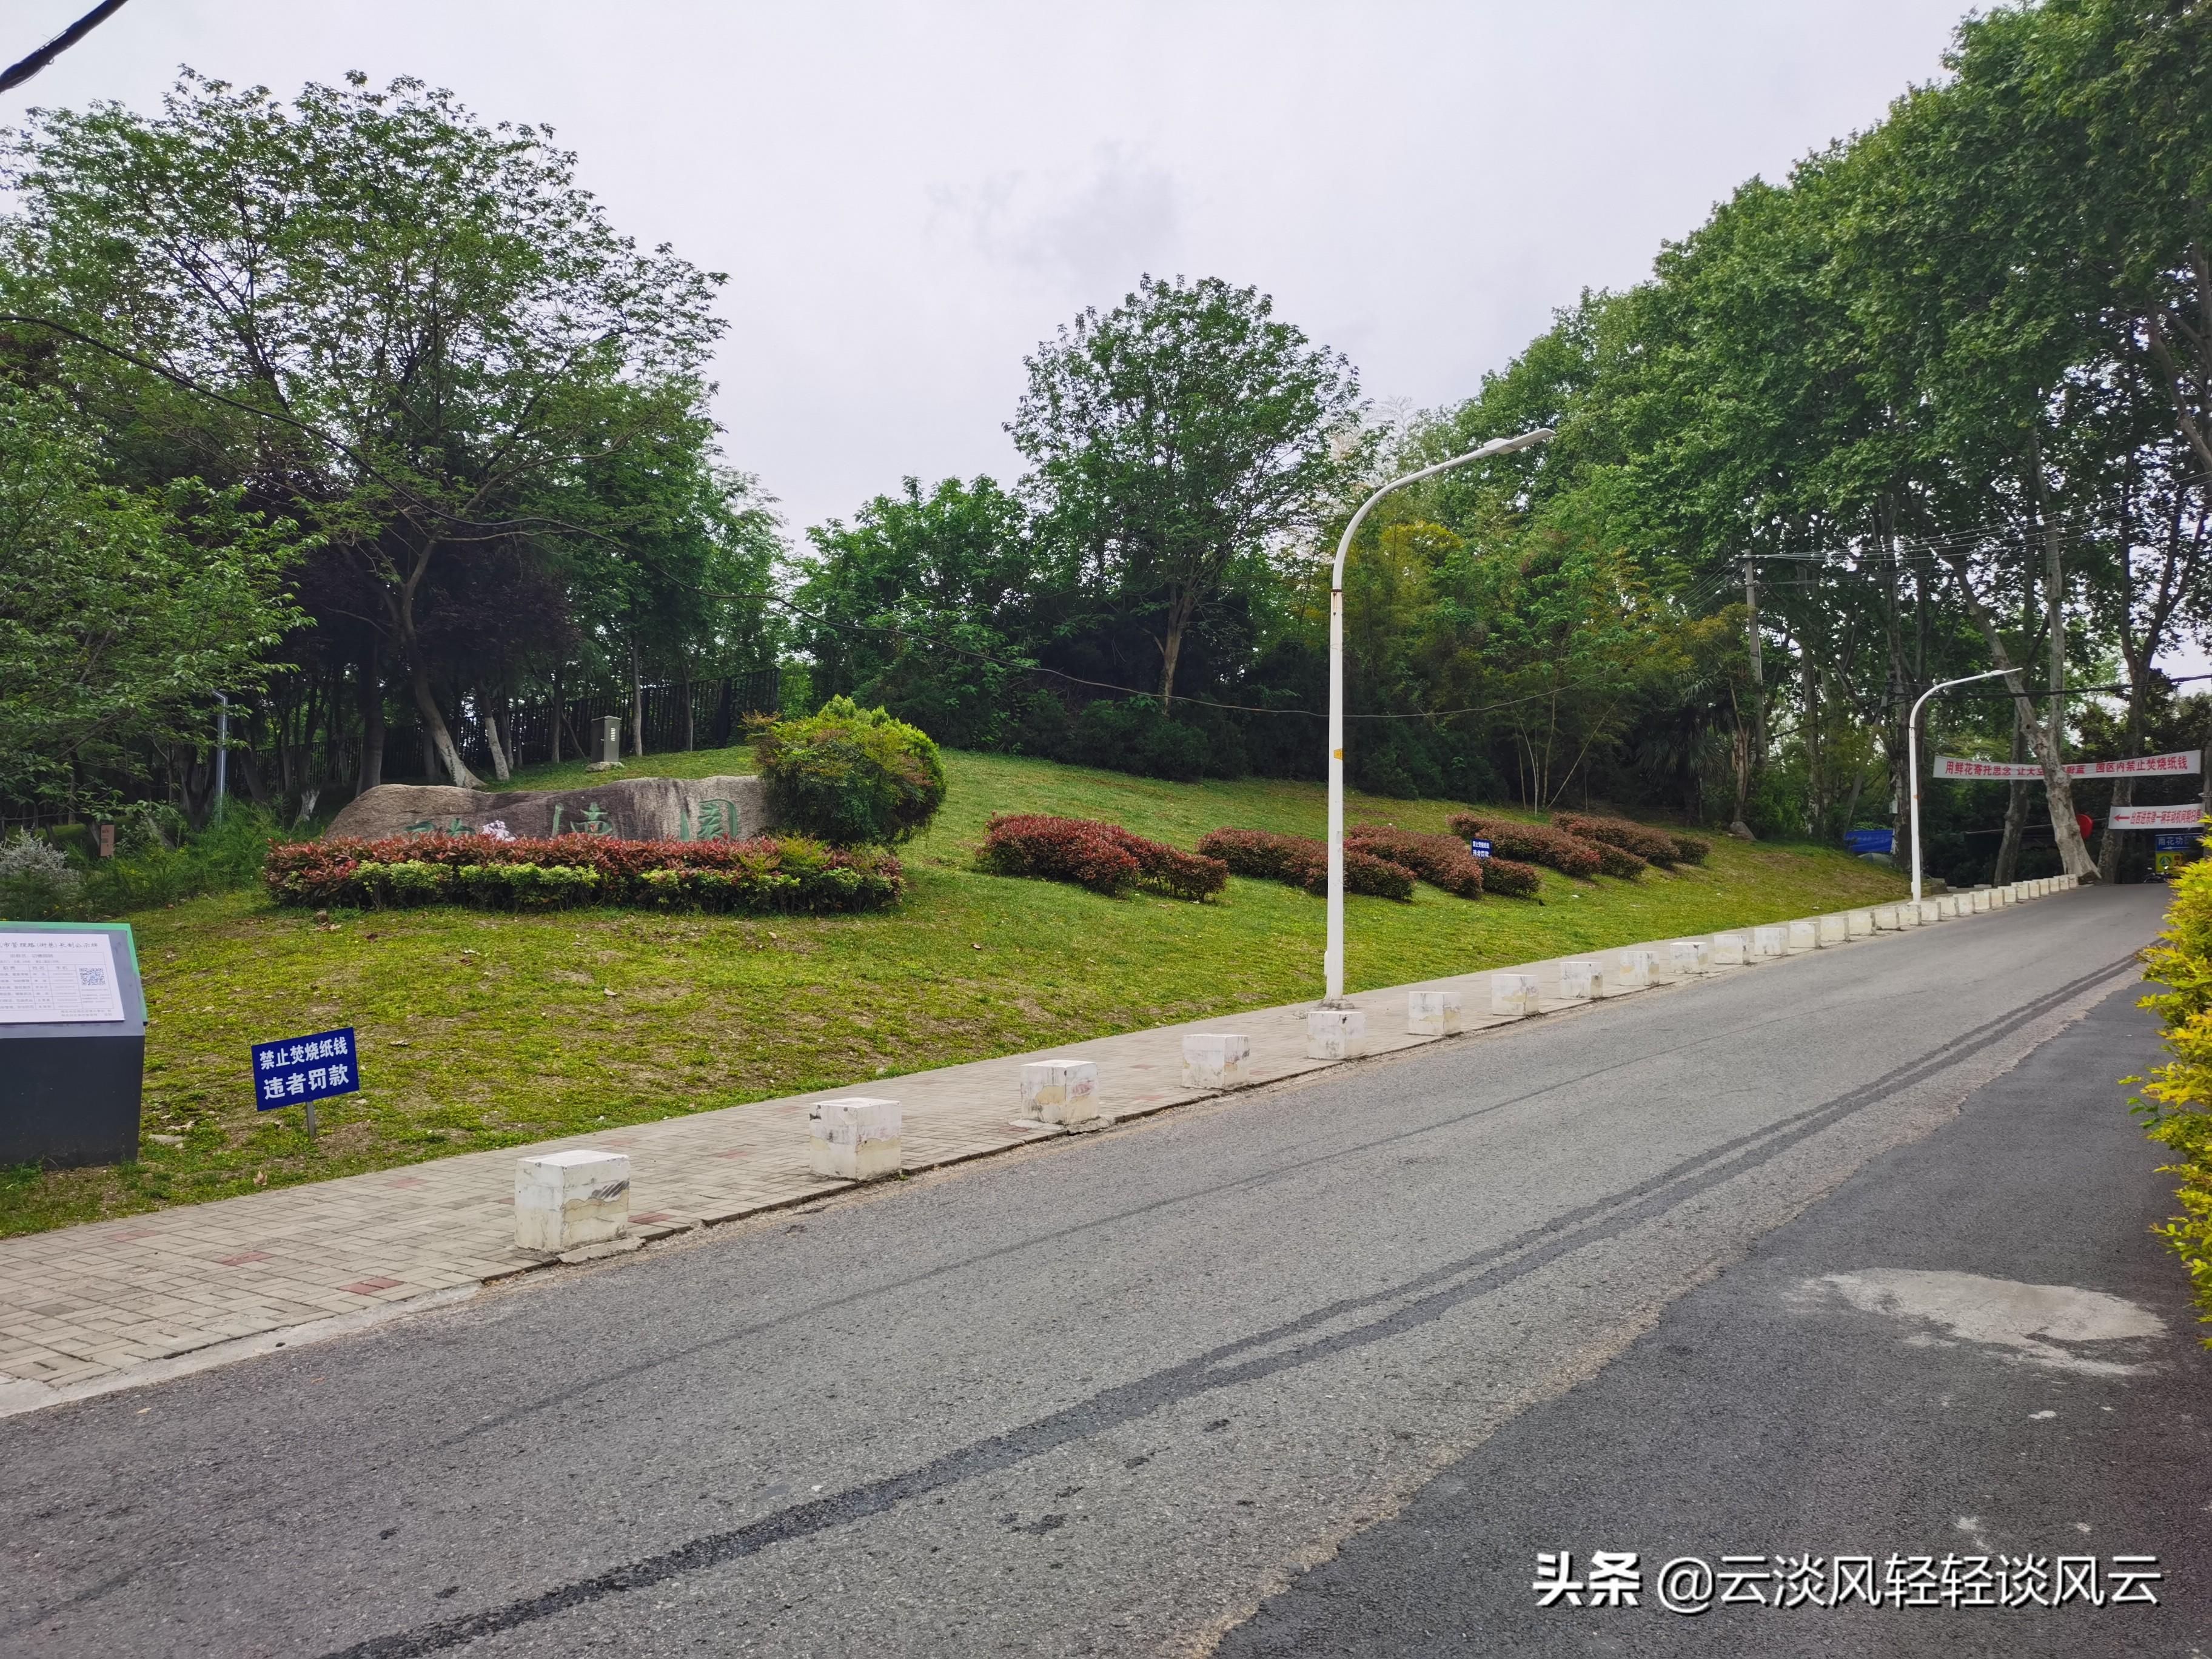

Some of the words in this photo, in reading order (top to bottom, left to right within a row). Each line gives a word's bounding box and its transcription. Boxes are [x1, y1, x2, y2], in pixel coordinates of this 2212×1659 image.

[1945, 761, 2011, 776] 用鲜花寄托思念
[2096, 756, 2188, 773] 园区内禁止焚烧纸钱
[260, 1036, 347, 1070] 禁止焚烧纸钱
[264, 1064, 349, 1100] 违者罚款
